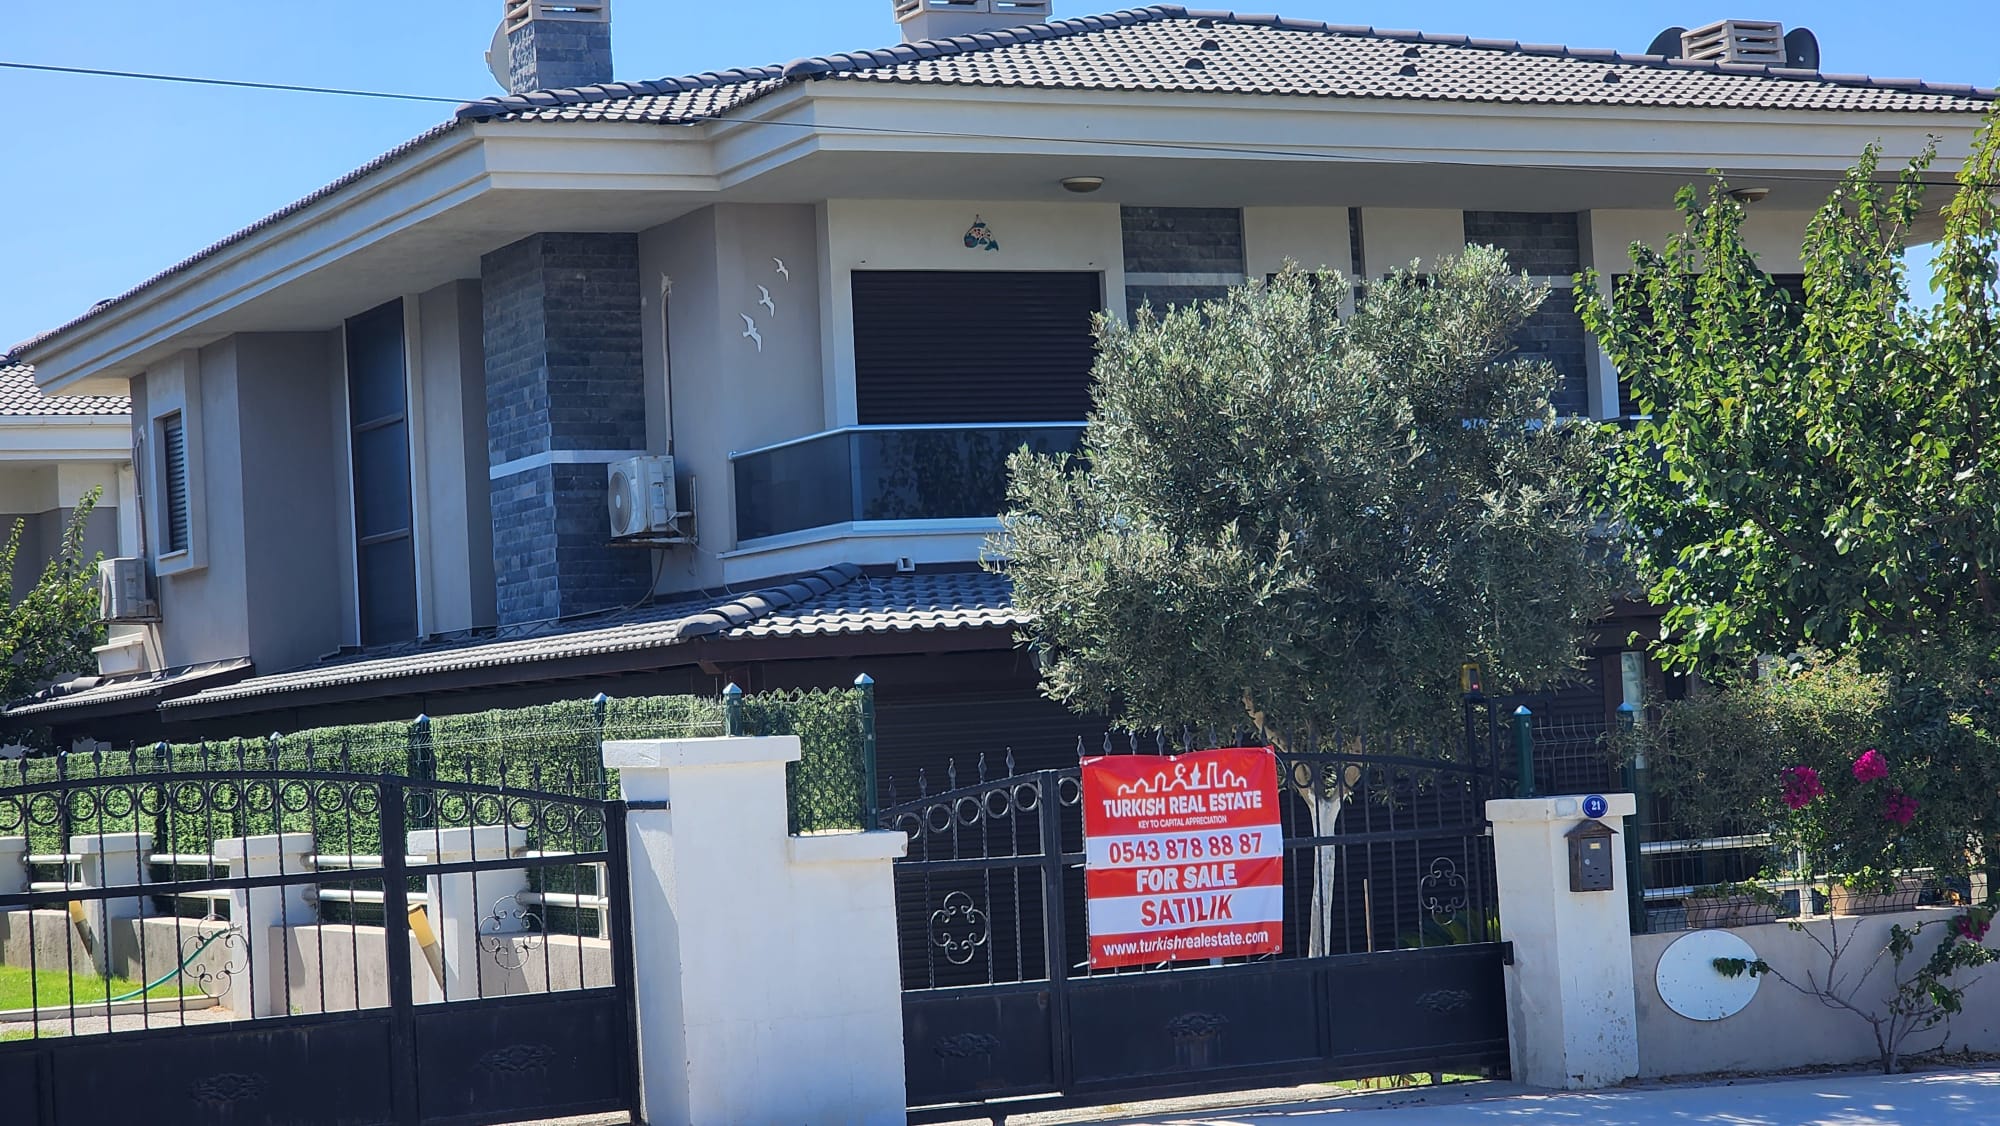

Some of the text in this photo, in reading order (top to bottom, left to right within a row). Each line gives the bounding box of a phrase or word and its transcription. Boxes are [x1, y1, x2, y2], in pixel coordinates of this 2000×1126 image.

[1102, 790, 1263, 818] TURKISH REAL ESTATE
[1591, 800, 1601, 810] 21
[1138, 815, 1227, 829] KEY TO CAPITAL APPRECIATION
[1109, 832, 1262, 864] 0543 878 88 87
[1136, 863, 1238, 892] FOR SALE
[1140, 893, 1233, 927] SATILIK
[1103, 930, 1269, 956] www.turkishrealestate.com
